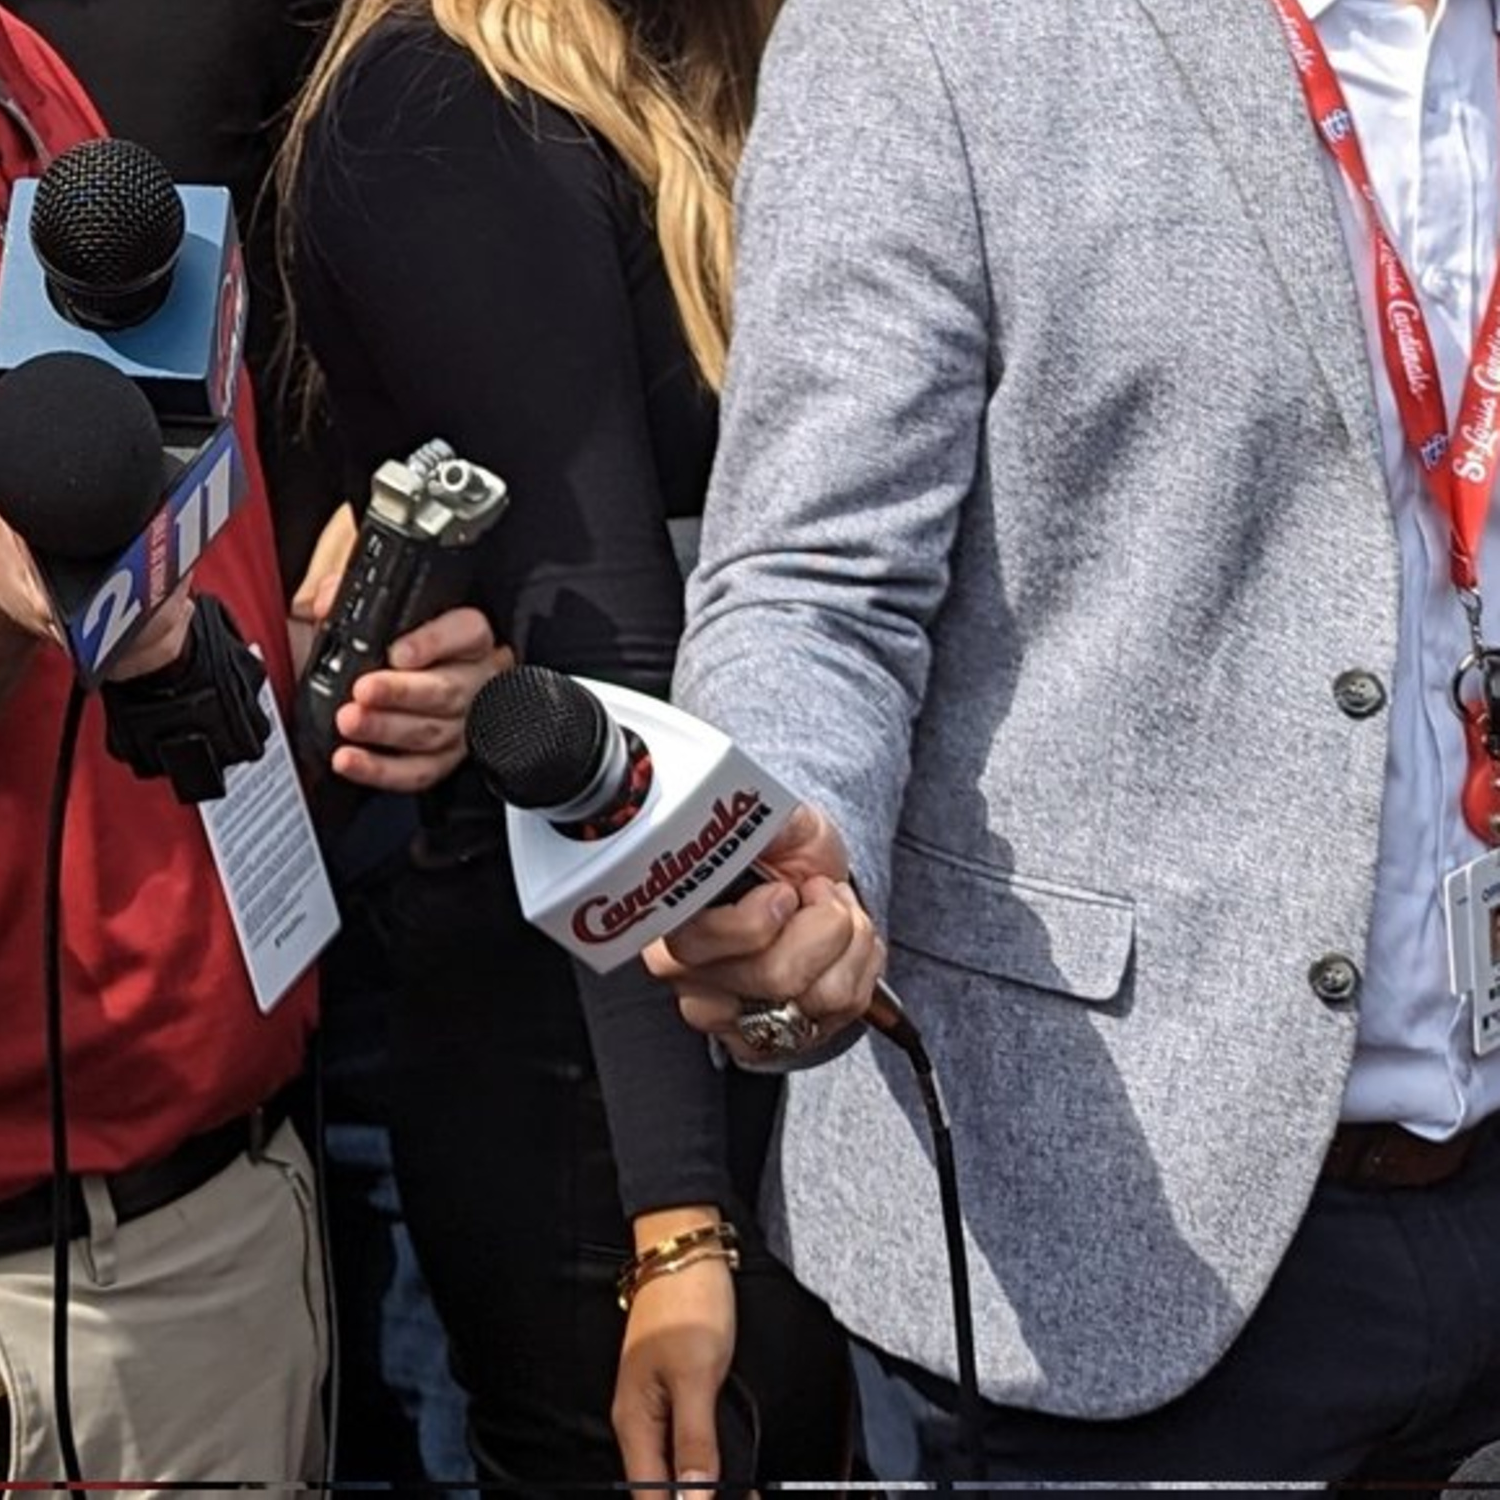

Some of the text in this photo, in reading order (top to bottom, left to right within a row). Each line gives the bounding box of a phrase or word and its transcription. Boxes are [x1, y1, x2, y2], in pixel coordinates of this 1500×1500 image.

[1386, 300, 1426, 399] Cardinals
[82, 568, 142, 673] 2
[174, 446, 233, 579] 11
[571, 785, 761, 944] Cardinals
[661, 802, 773, 908] INSIDER
